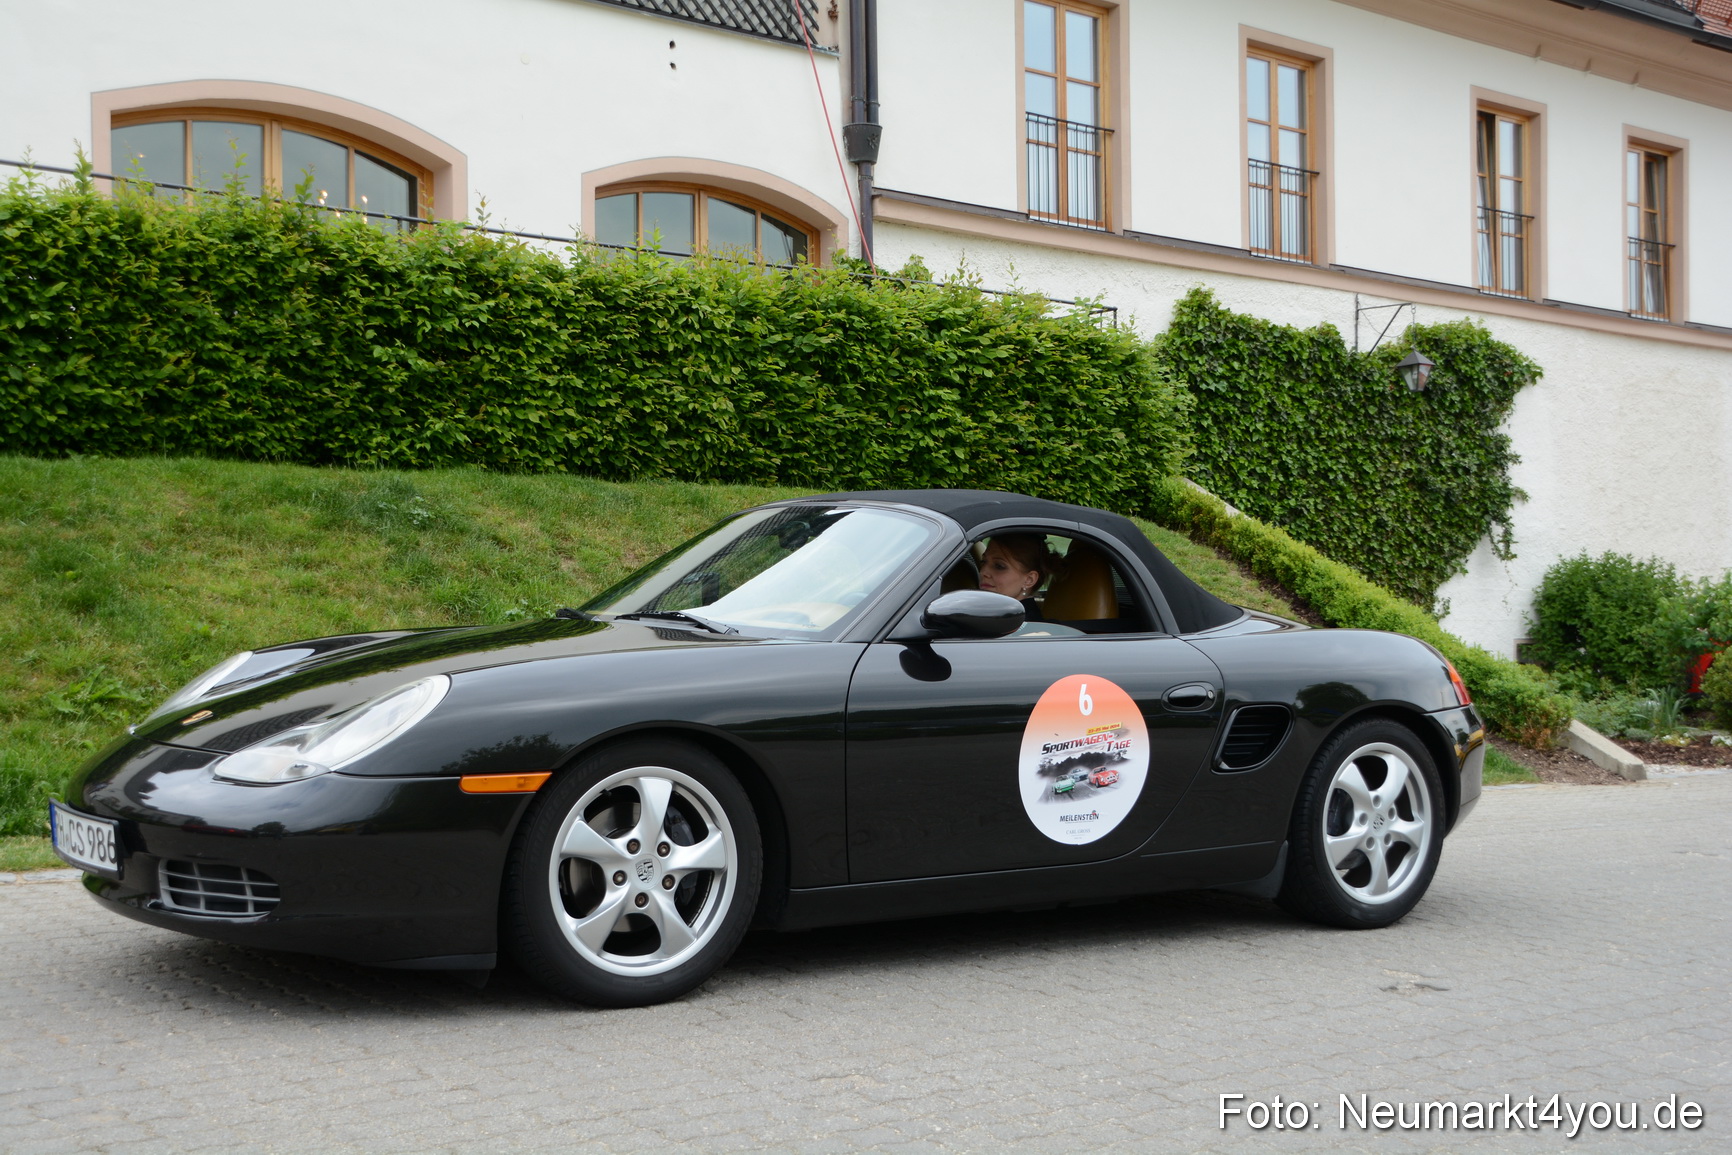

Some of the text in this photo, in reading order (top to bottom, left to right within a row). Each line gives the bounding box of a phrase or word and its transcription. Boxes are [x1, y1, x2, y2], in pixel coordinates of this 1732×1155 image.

[1079, 684, 1093, 716] 6
[1107, 739, 1132, 752] TAGE
[69, 819, 85, 856] CS
[87, 825, 117, 864] 986
